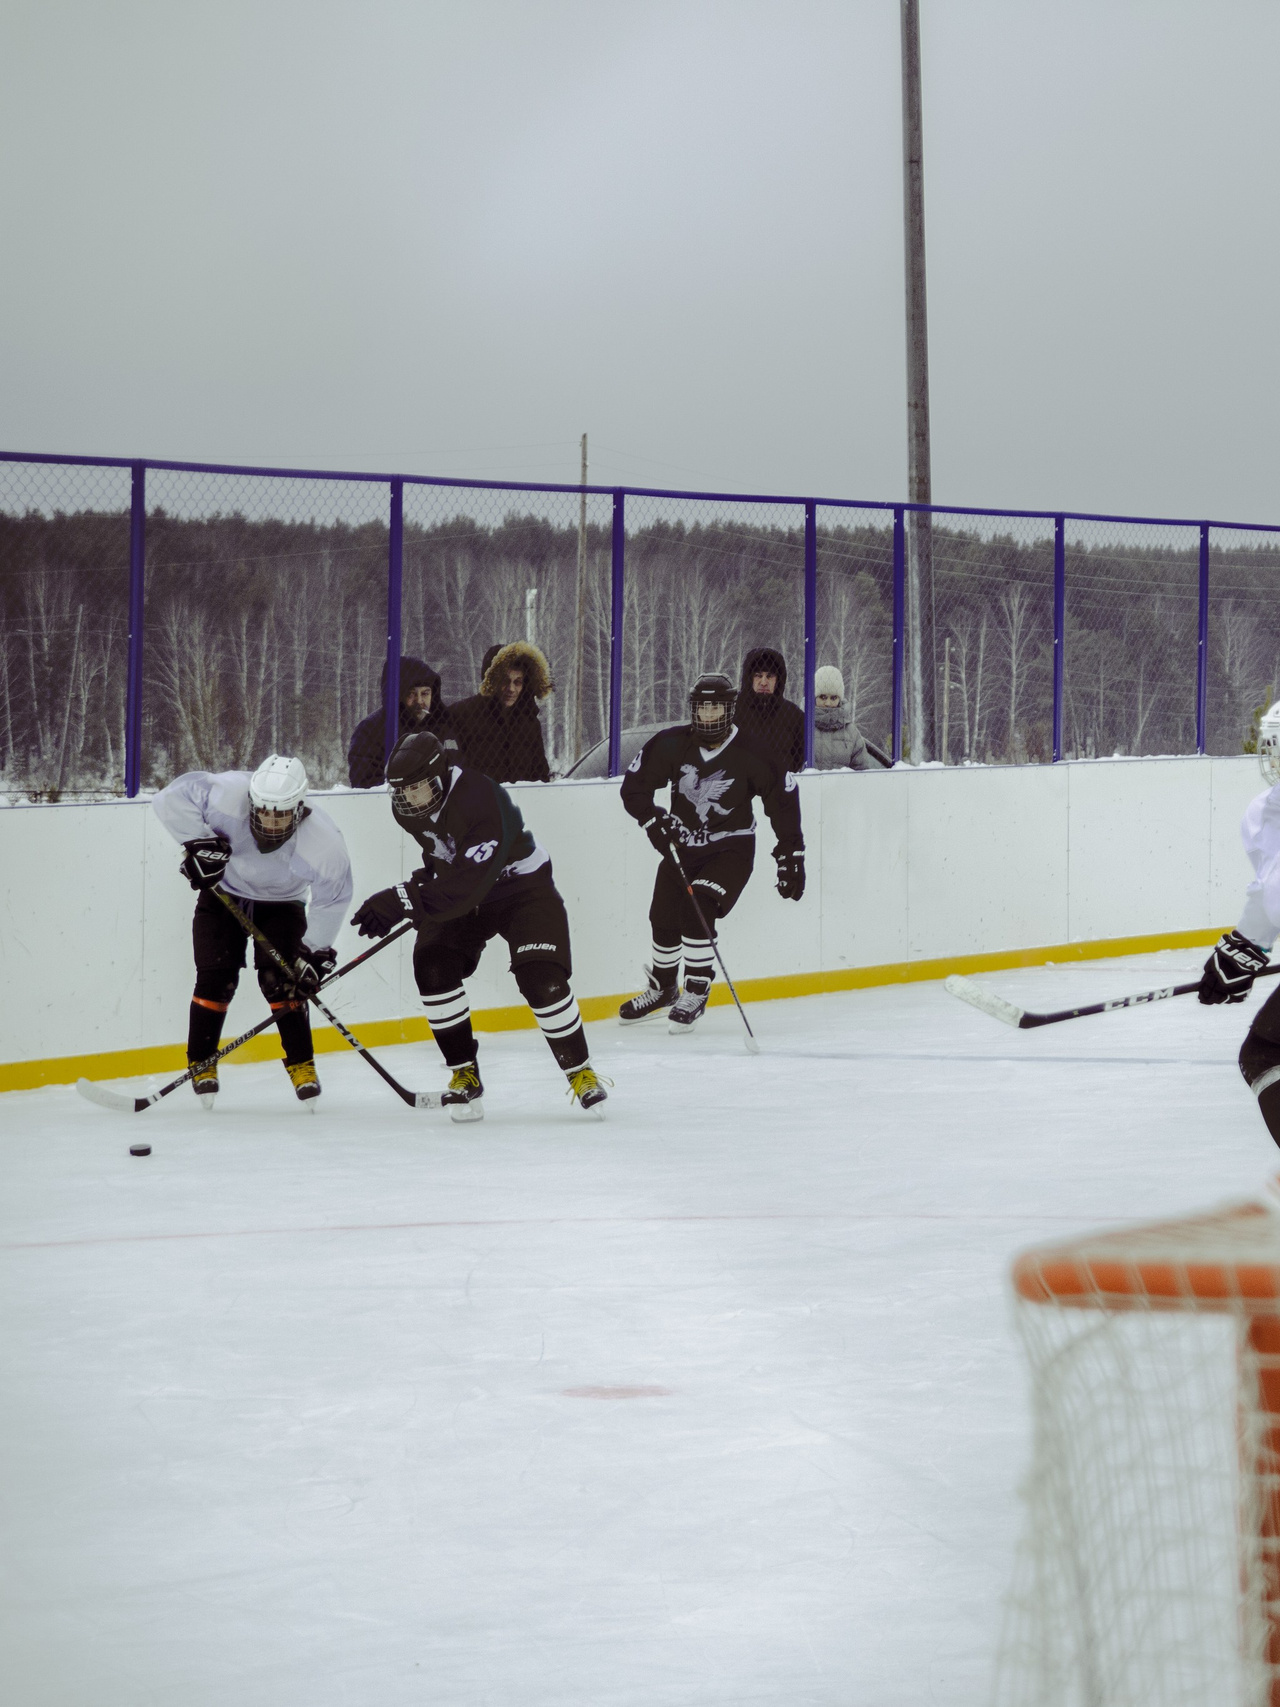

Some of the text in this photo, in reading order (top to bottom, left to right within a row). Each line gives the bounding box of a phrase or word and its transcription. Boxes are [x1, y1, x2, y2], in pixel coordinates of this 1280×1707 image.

[517, 942, 556, 953] BAUER
[1104, 987, 1174, 1012] CCM
[318, 1003, 365, 1051] CCM
